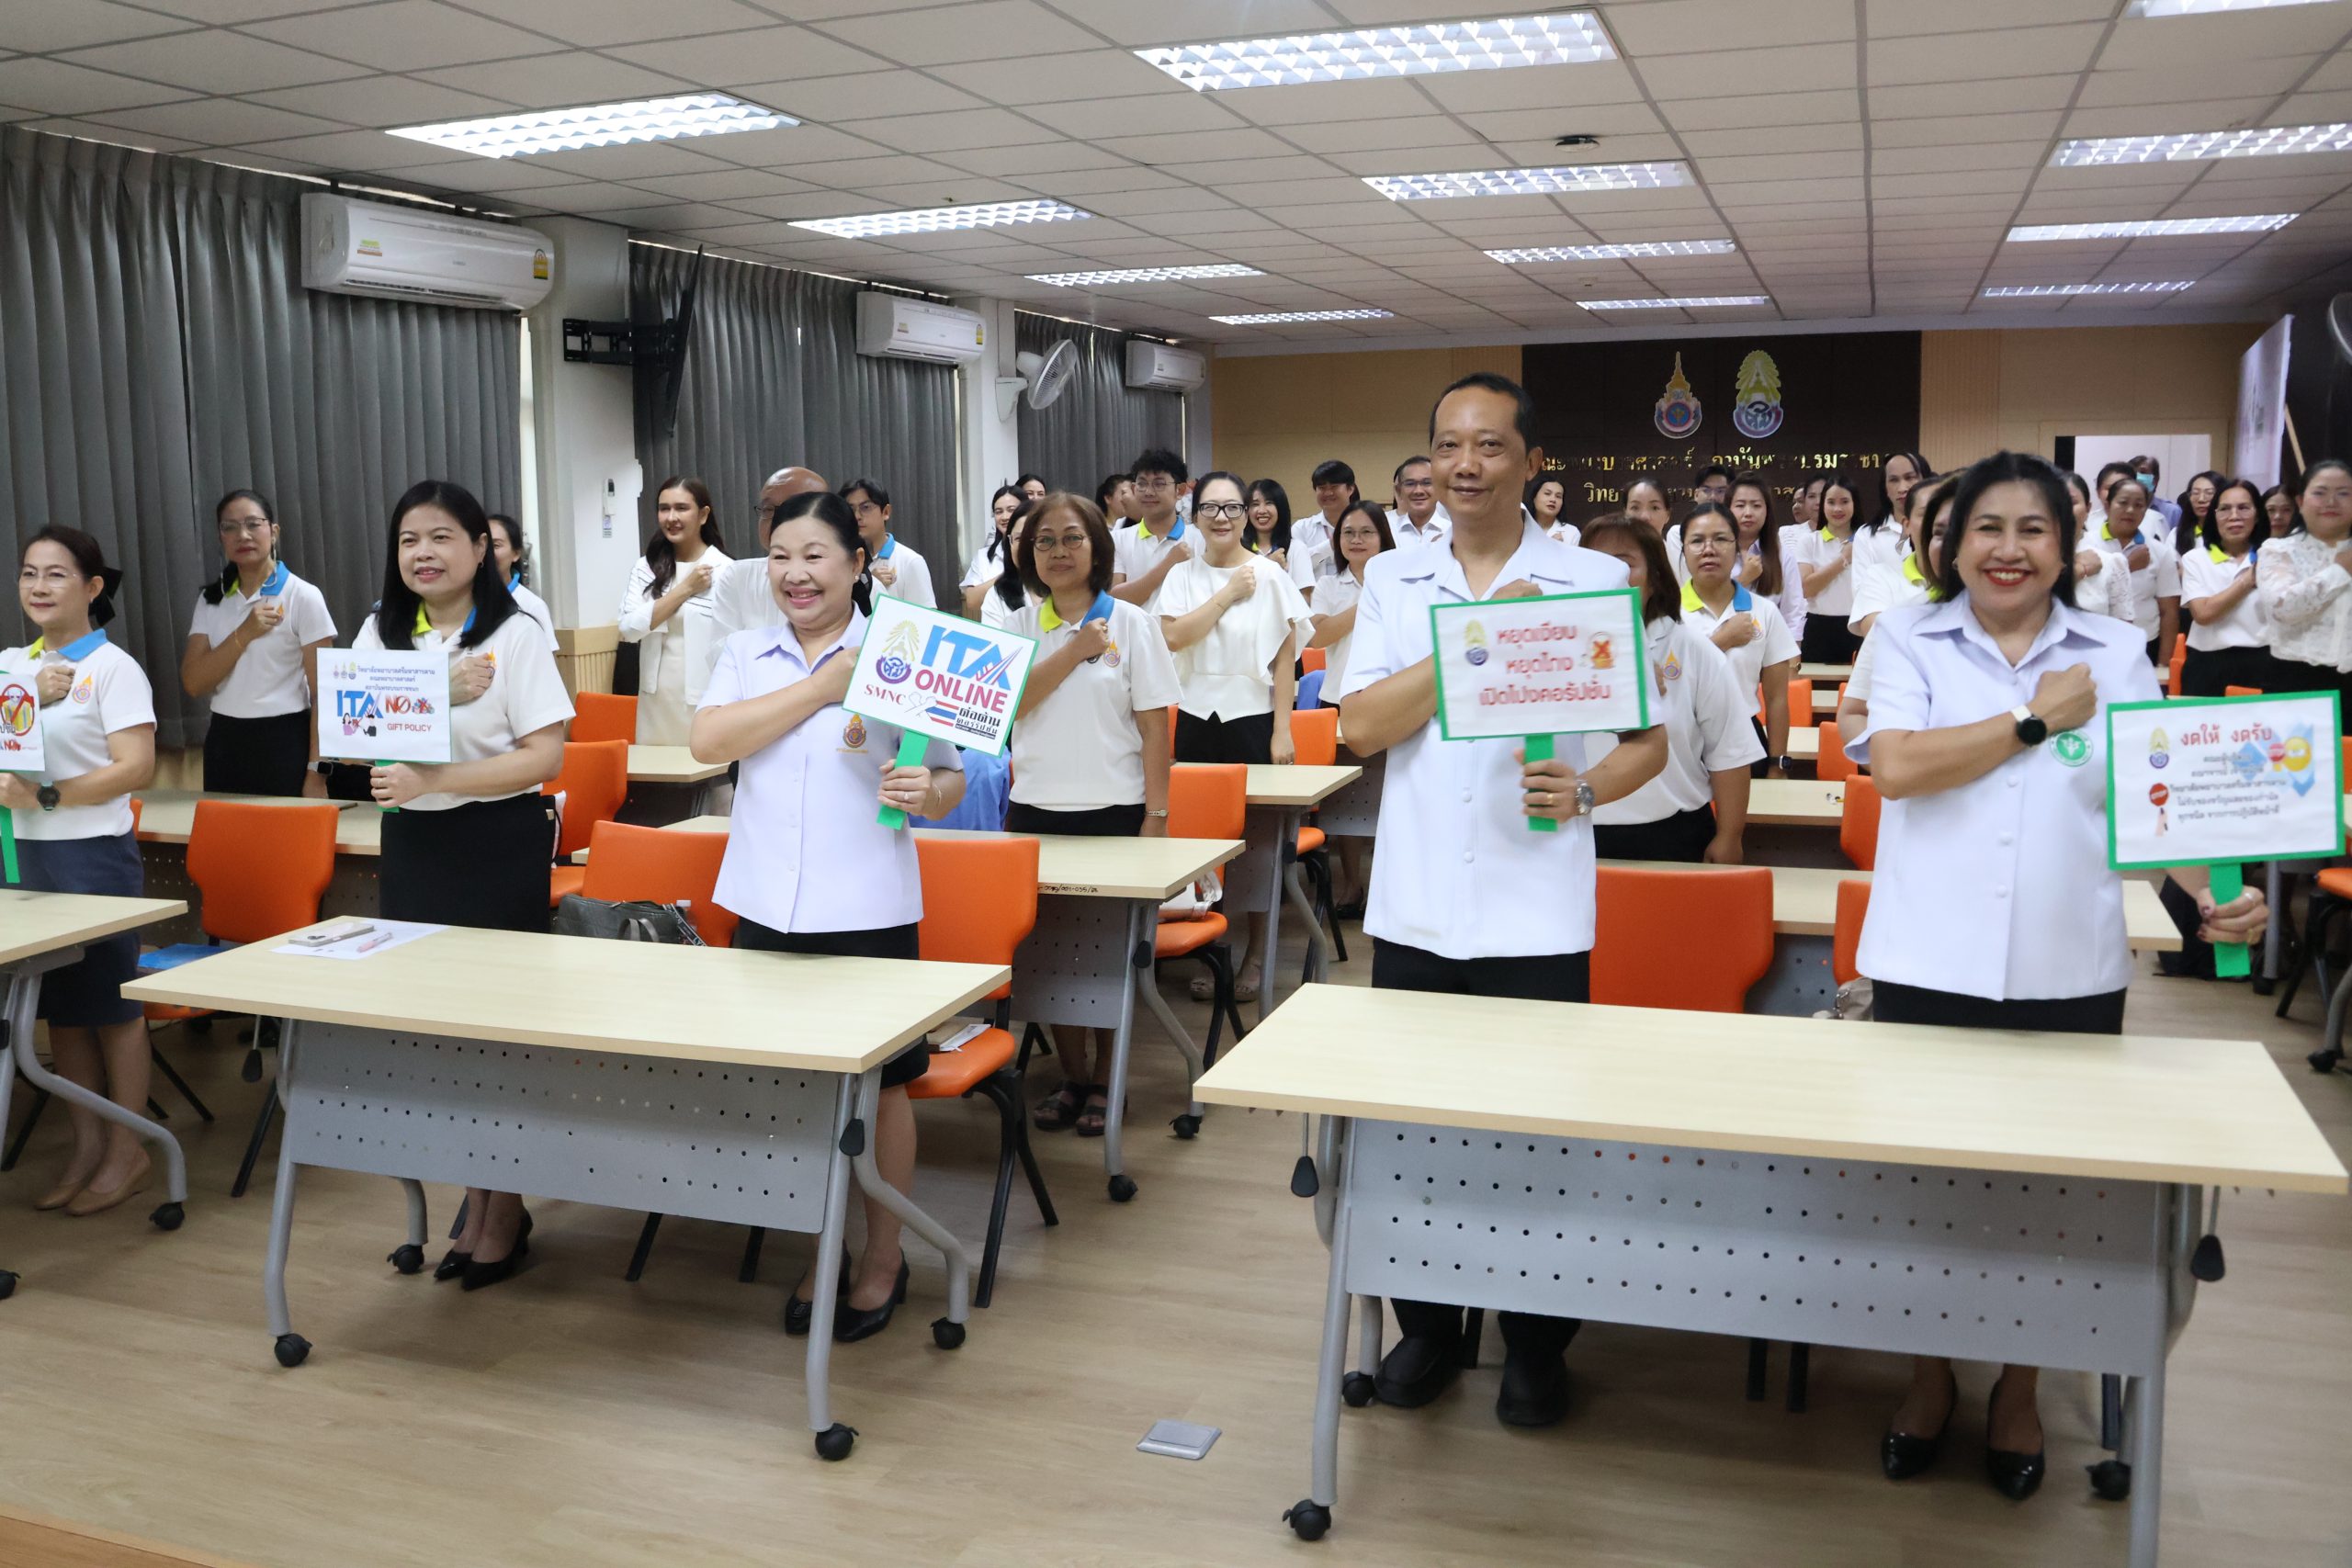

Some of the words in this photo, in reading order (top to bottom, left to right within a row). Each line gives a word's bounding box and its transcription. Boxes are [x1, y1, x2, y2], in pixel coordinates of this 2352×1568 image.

[921, 625, 1016, 691] ITA
[864, 683, 907, 705] SMNC
[915, 669, 1008, 714] ONLINE
[336, 690, 384, 719] ITA
[387, 723, 403, 731] GIFT
[404, 723, 432, 732] POLICY
[959, 706, 1001, 728] ต่อต้าน
[2180, 723, 2220, 746] งดให้
[2231, 722, 2273, 742] งดรับ
